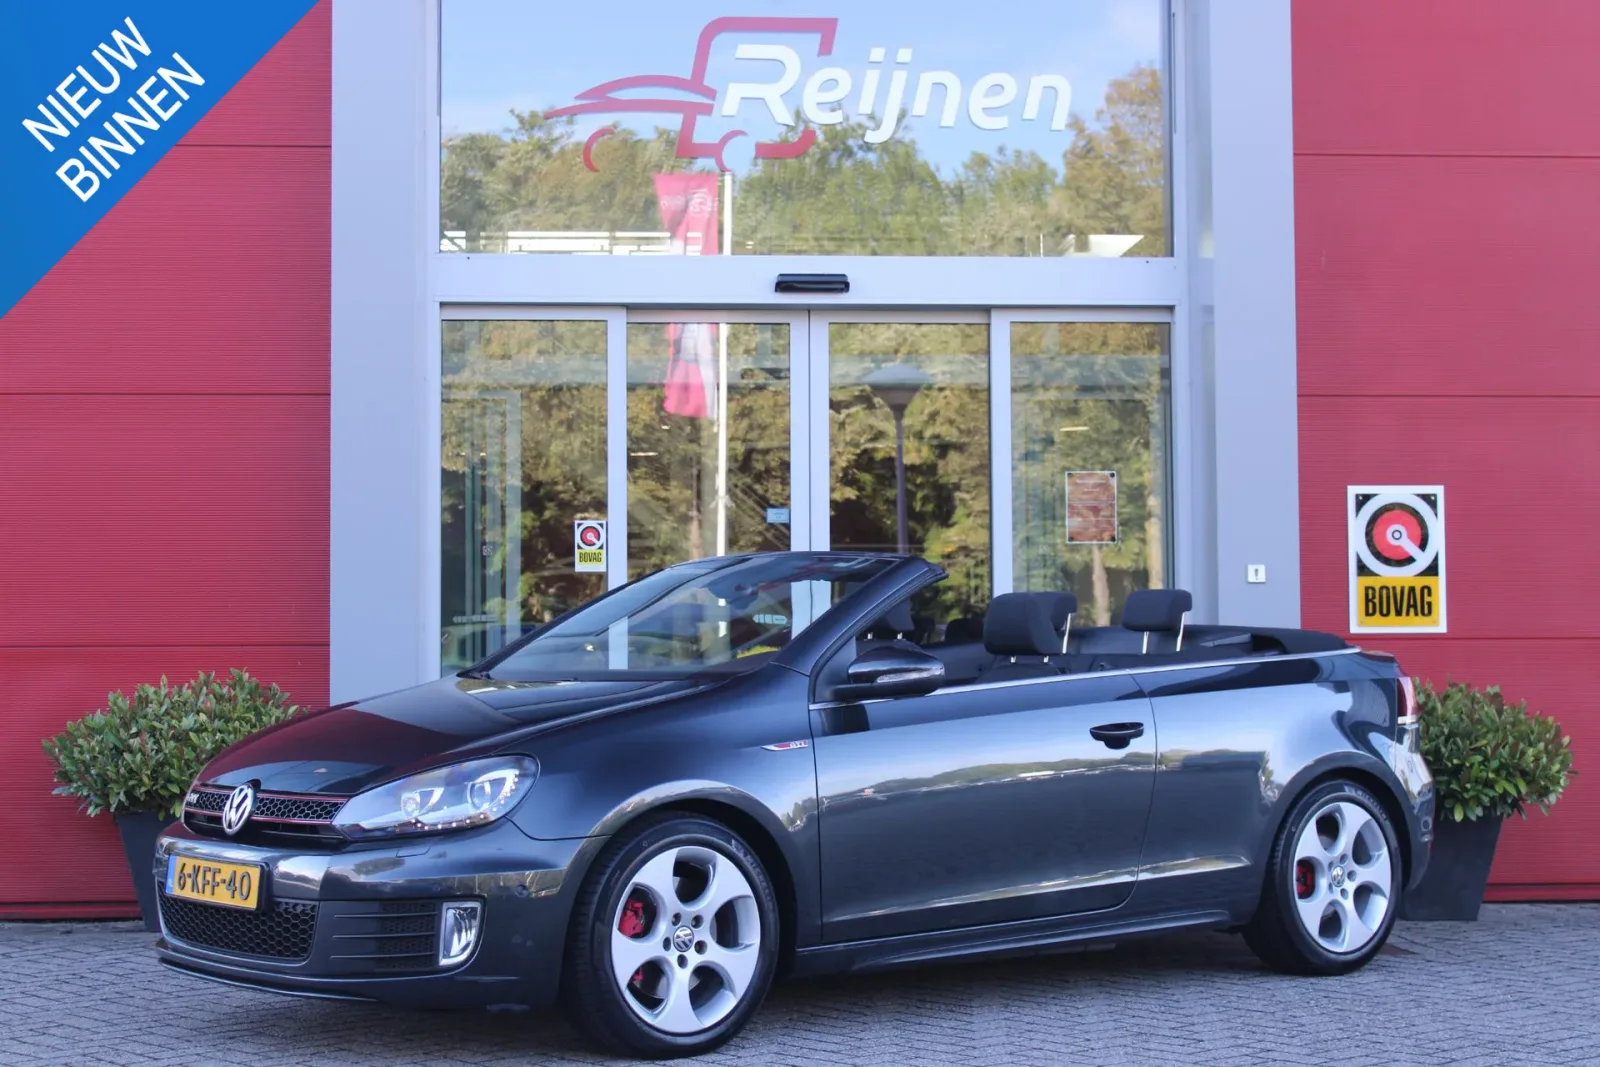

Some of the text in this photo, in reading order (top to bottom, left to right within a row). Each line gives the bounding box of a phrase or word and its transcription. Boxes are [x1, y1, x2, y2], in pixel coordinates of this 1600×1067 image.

[721, 43, 1073, 144] Reijnen
[579, 551, 602, 563] BOVAG
[1364, 585, 1432, 617] BOVAG
[178, 863, 252, 901] 6-KFF-40
